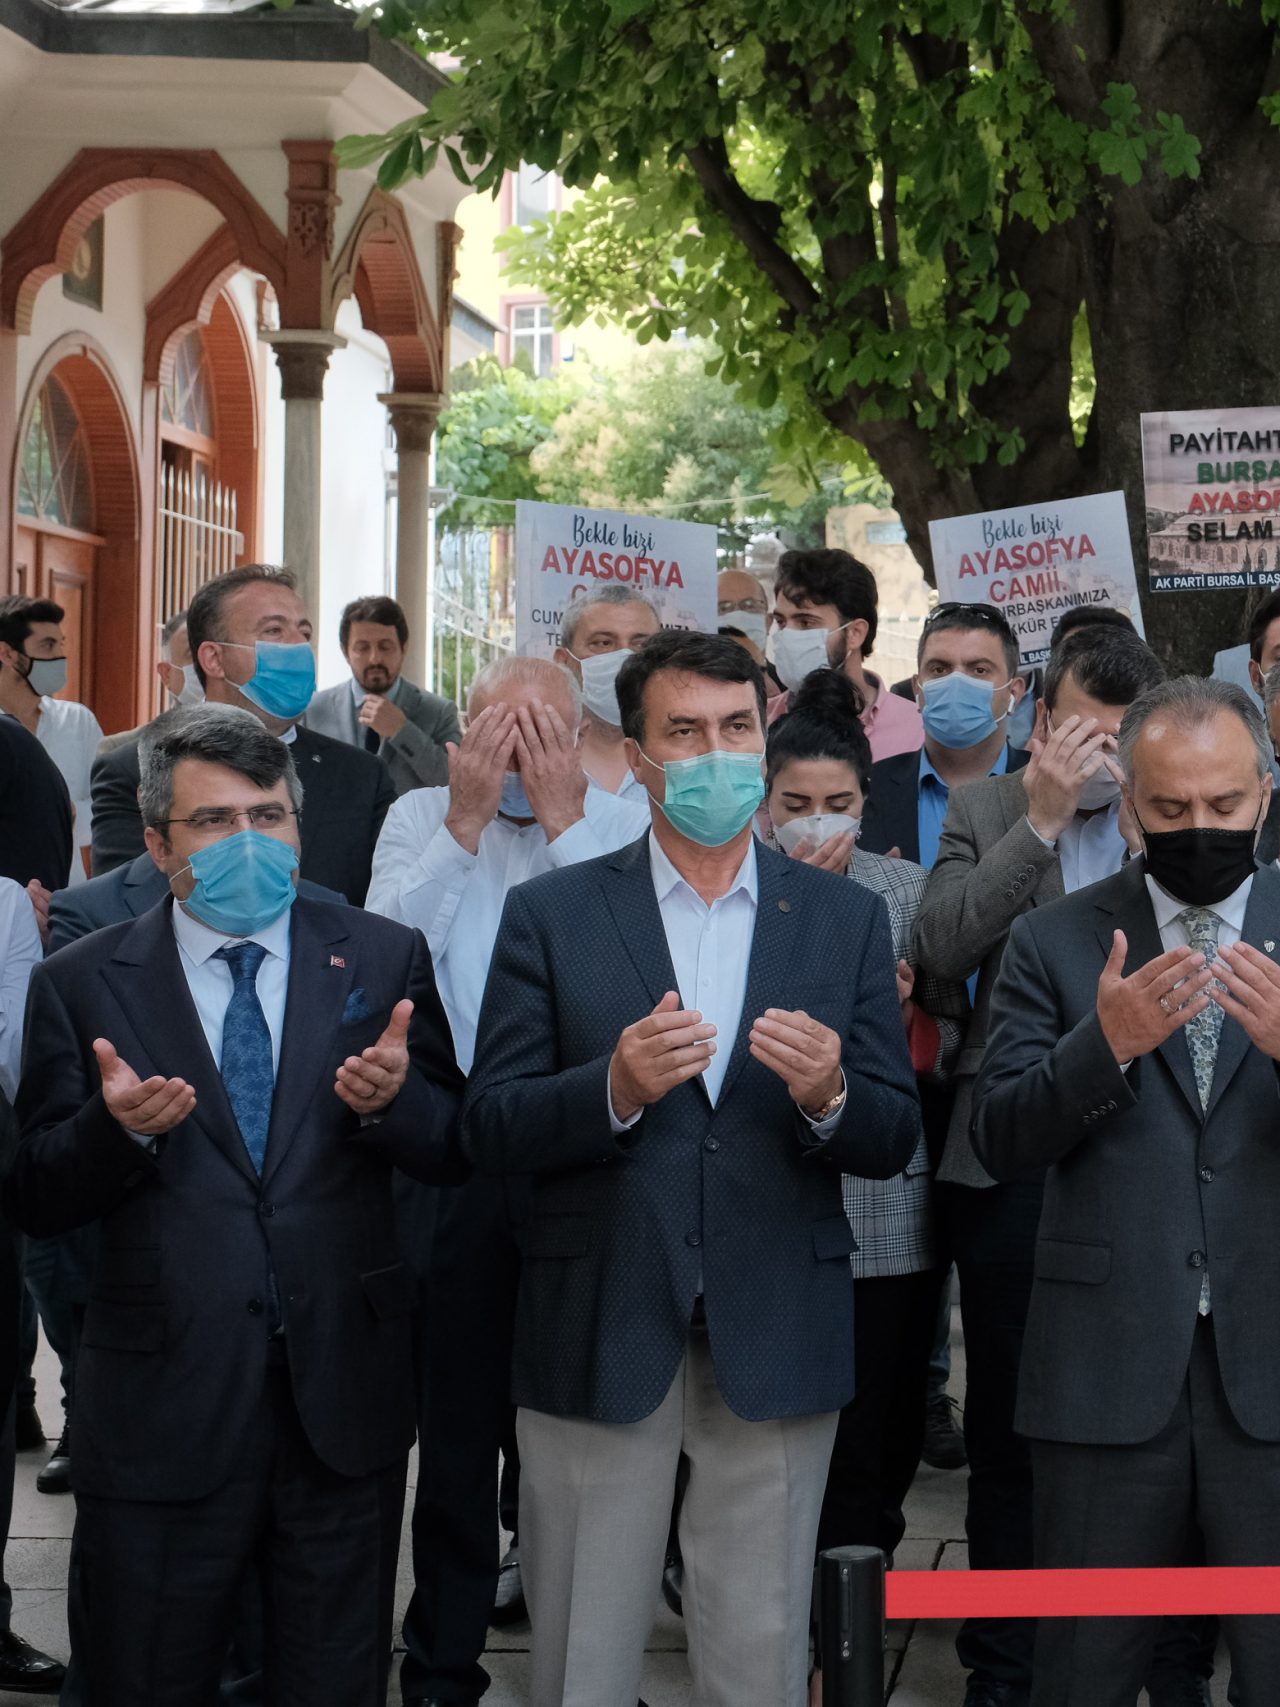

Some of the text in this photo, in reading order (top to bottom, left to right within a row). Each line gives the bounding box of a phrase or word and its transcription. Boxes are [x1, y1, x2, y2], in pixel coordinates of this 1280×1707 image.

[573, 514, 655, 559] Bekle bizi
[982, 514, 1063, 548] Bekle bizi
[1187, 520, 1273, 542] SELAM
[541, 545, 684, 589] AYASOFYA
[958, 534, 1096, 579] AYASOFYA
[1155, 577, 1171, 589] AK
[1173, 574, 1204, 588] PARTİ
[1207, 574, 1243, 587] BURSA
[1246, 572, 1256, 585] İL
[1002, 588, 1110, 617] RBAŞKANIMIZA
[1011, 618, 1047, 637] KKÜR
